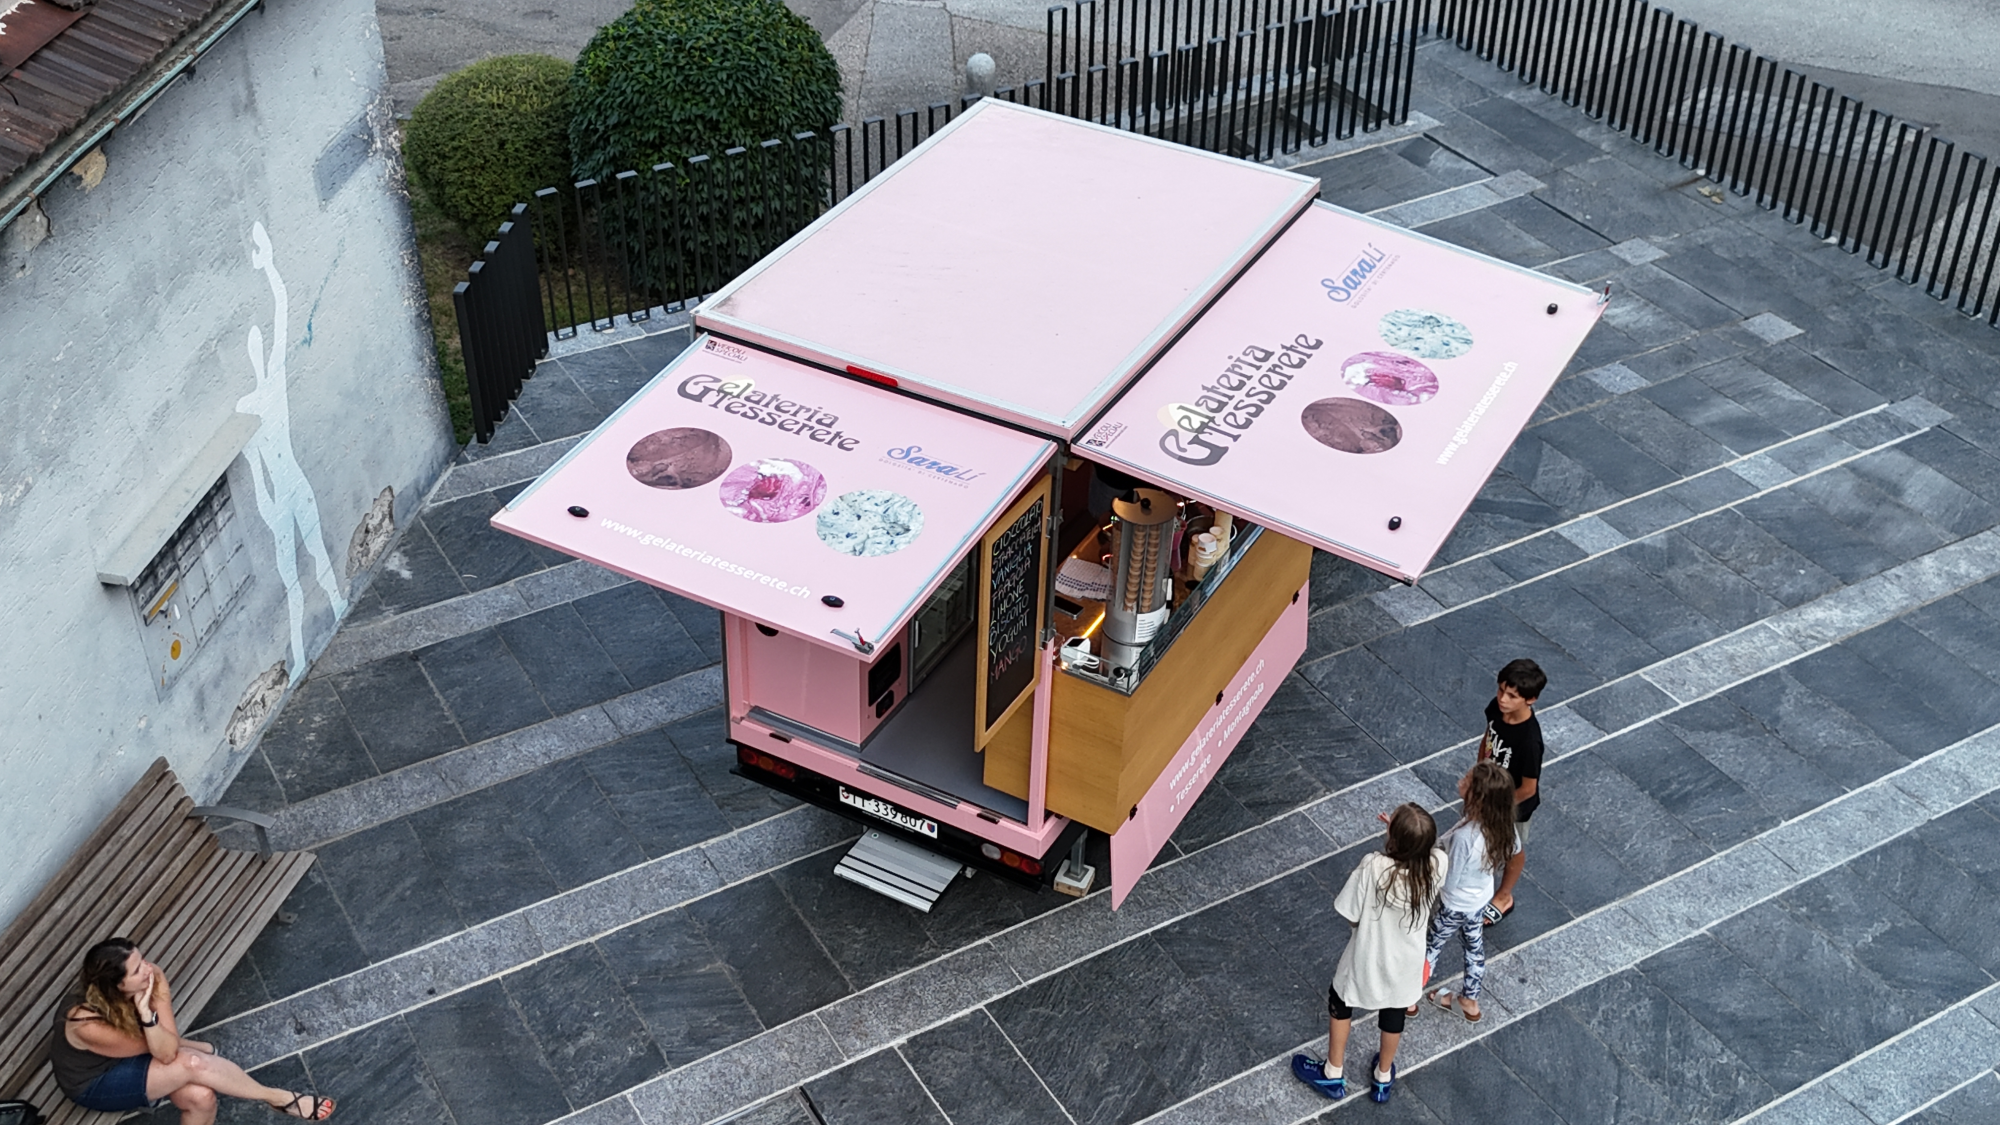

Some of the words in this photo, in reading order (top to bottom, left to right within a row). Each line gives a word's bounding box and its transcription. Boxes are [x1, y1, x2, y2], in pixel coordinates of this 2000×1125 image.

[677, 374, 840, 429] Gelateria
[708, 389, 861, 451] Tesserete
[1159, 345, 1275, 467] Gelateria
[1195, 333, 1324, 443] Tesserete
[1435, 360, 1519, 466] www.gelateriatesserete.ch
[599, 516, 812, 600] www.gelateriatesserete.ch
[991, 556, 1031, 608] FRAGOLA
[990, 608, 1030, 664] YOGURT
[990, 635, 1028, 685] MANGO
[1168, 658, 1266, 791] www.gelateriatesserete.ch
[1175, 753, 1212, 806] Tesserete
[1223, 681, 1265, 742] Montagnola
